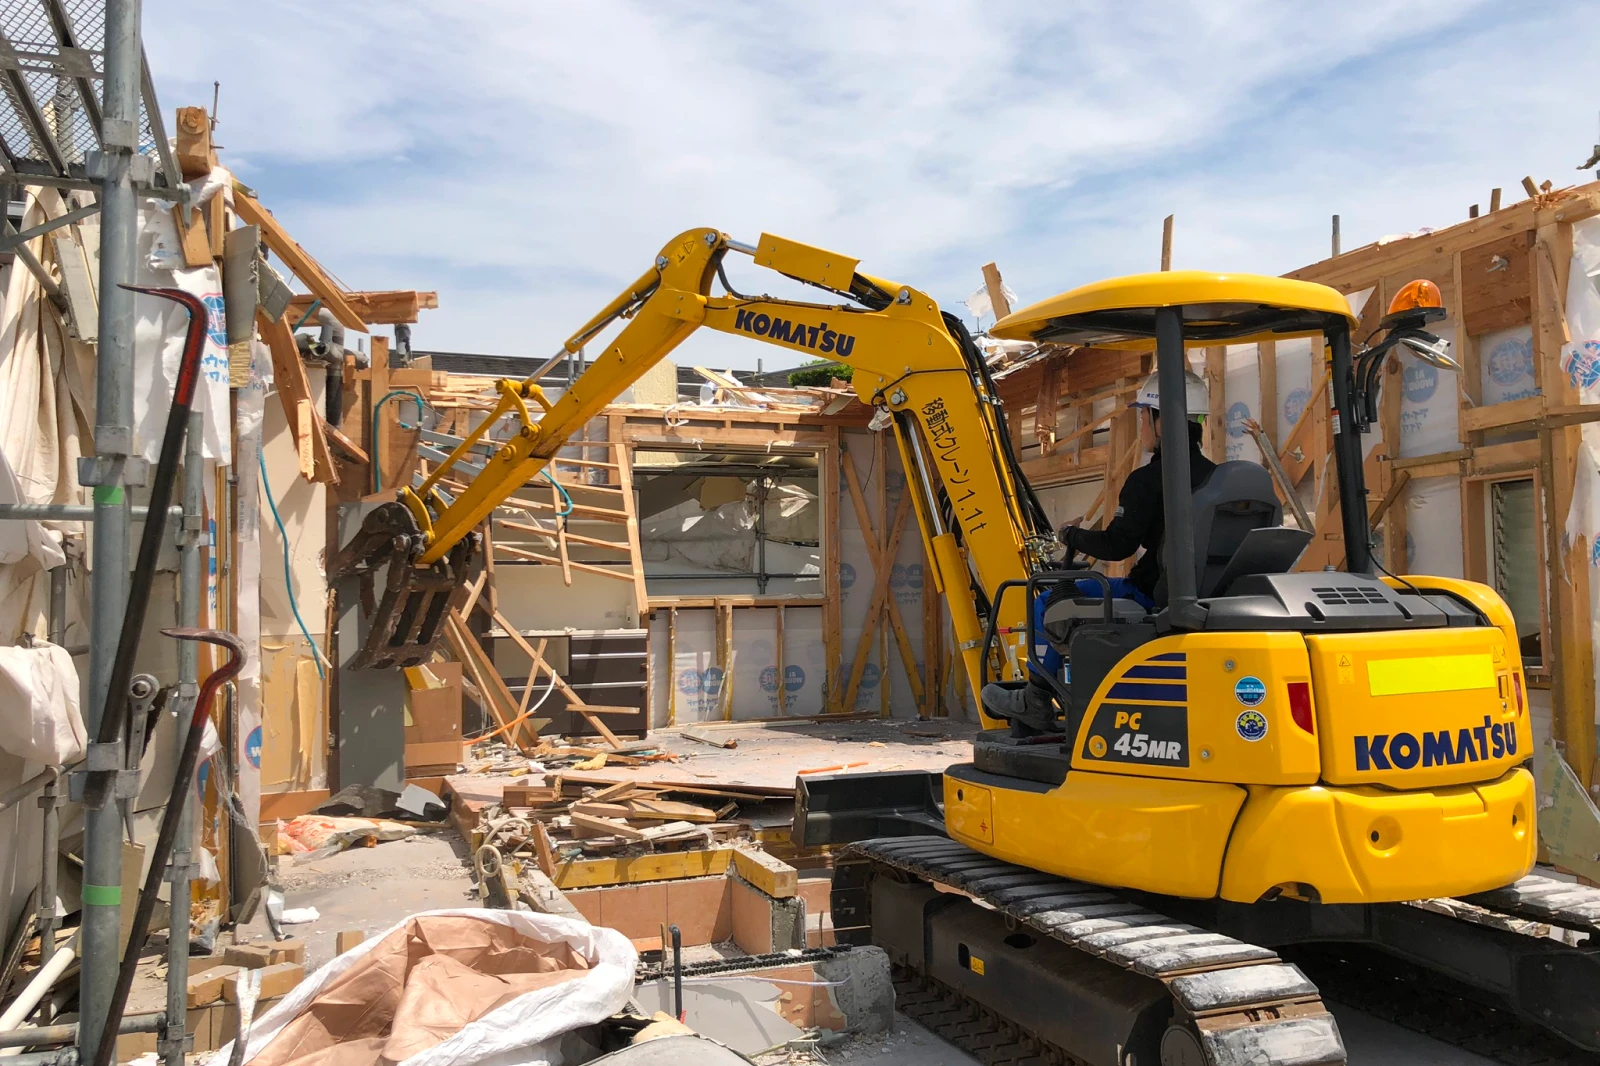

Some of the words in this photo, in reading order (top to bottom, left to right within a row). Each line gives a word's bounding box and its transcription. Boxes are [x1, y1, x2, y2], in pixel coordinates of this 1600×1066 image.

[735, 308, 856, 357] KOMATSU
[1114, 711, 1142, 730] PC
[1113, 733, 1181, 760] 45MR
[1354, 715, 1517, 771] KOMATSU
